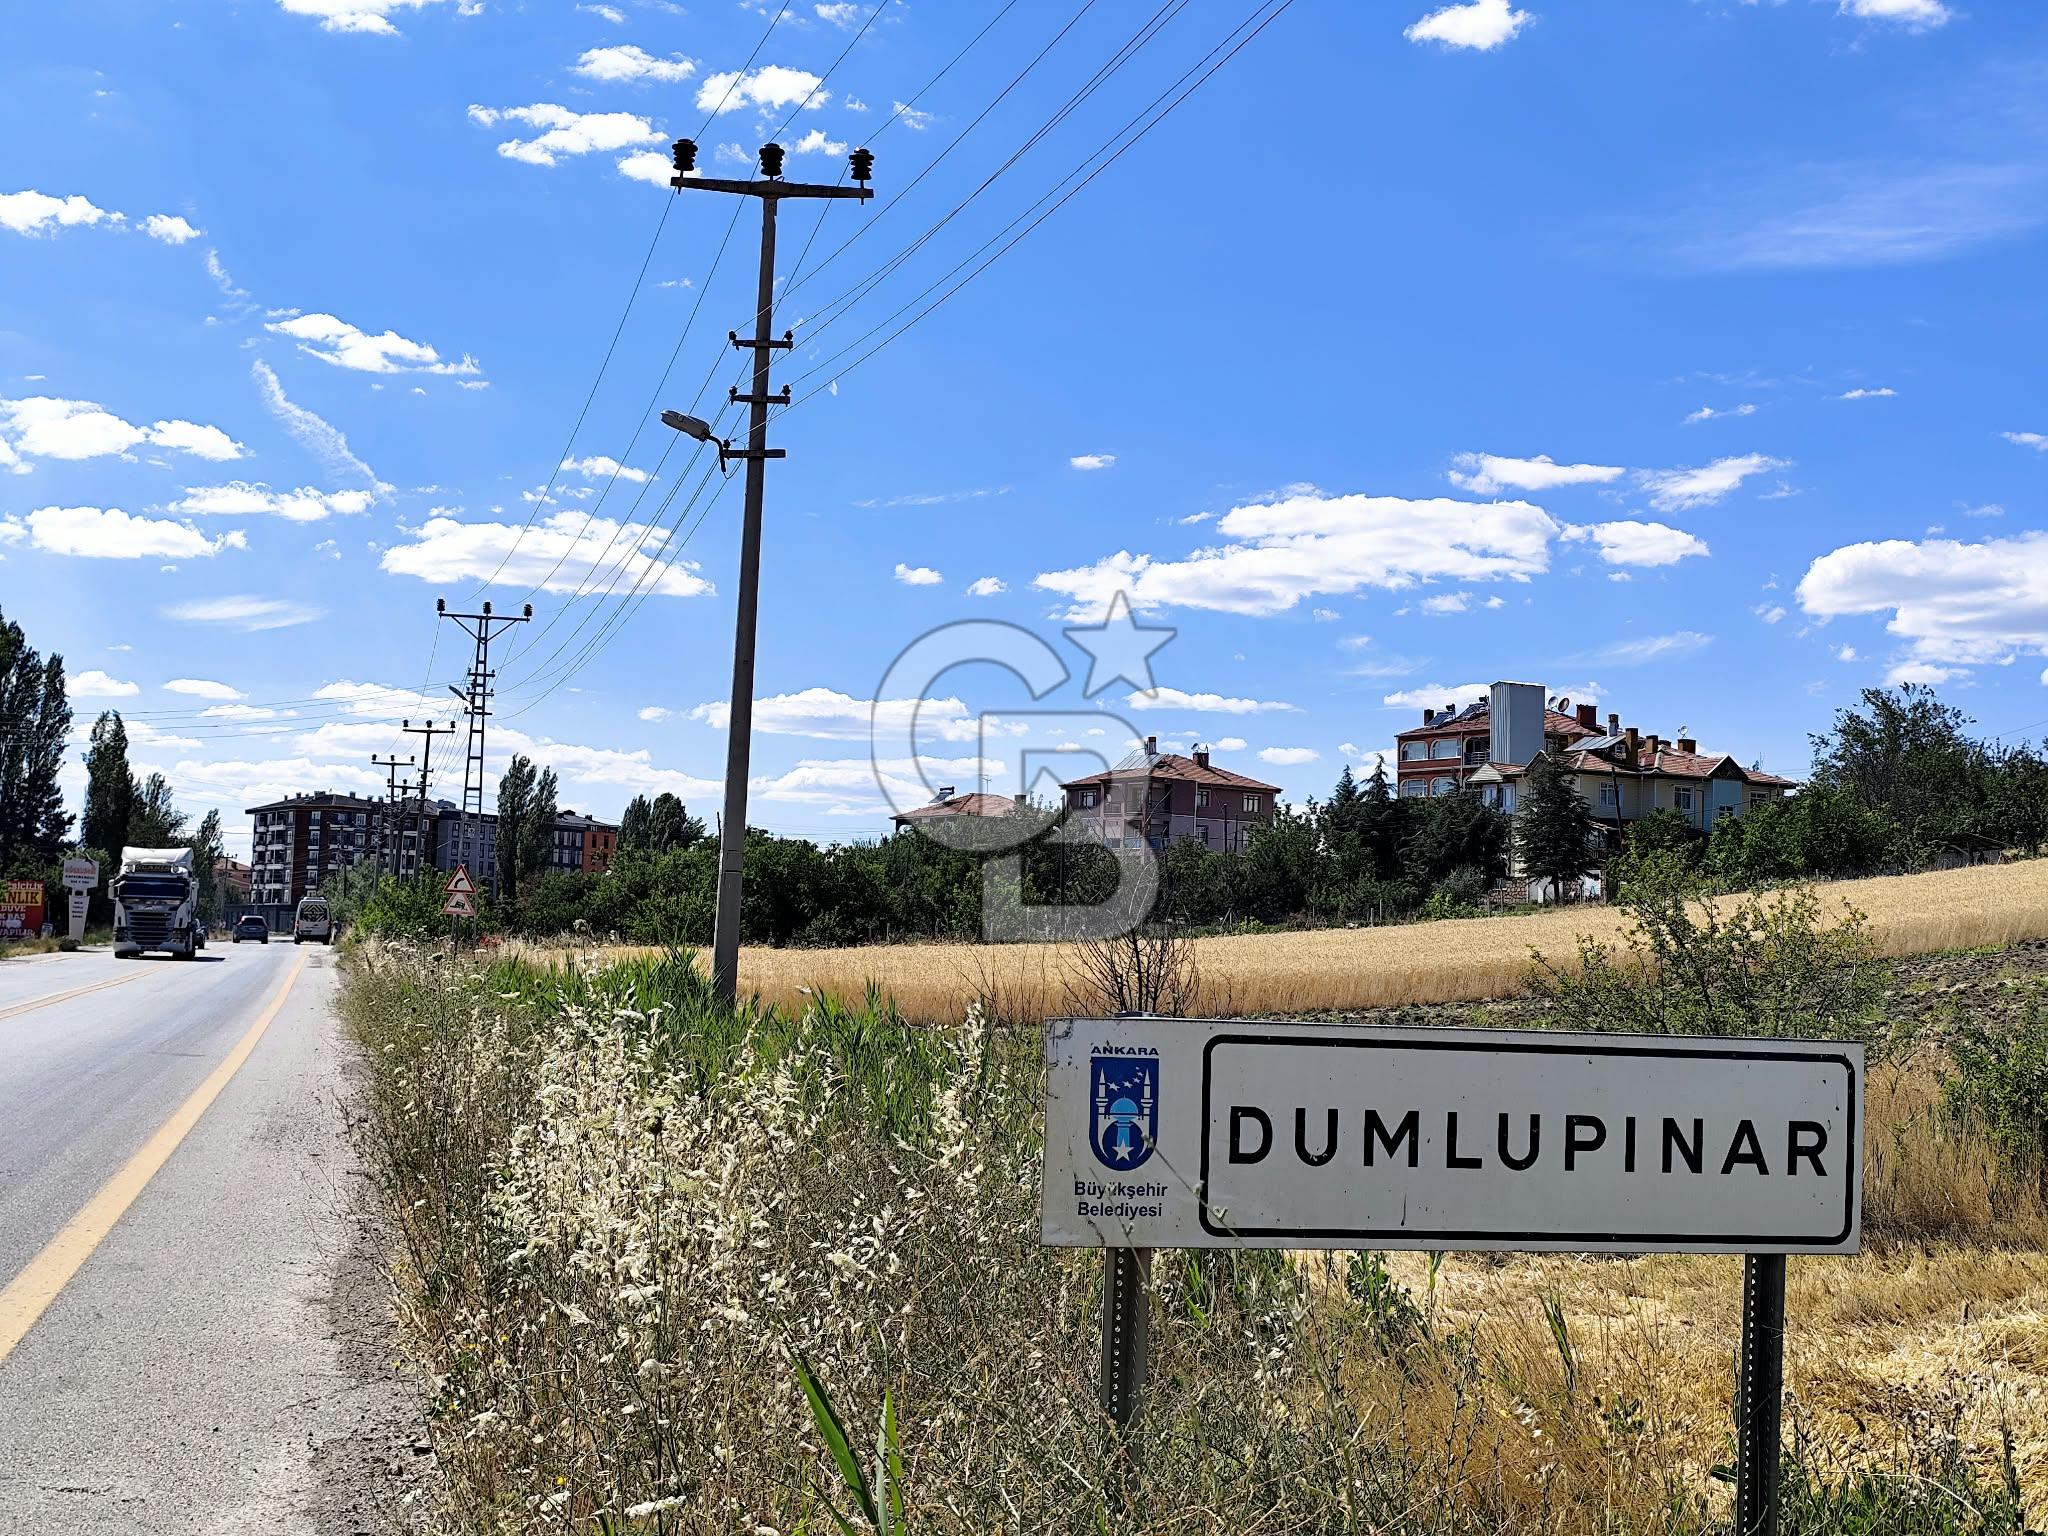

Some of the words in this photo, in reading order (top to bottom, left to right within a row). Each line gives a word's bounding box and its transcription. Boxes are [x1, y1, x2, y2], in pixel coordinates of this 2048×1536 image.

[1091, 1046, 1159, 1056] ANKARA
[1229, 1106, 1827, 1176] DUMLUPINAR
[1077, 1202, 1162, 1220] Belediyesi
